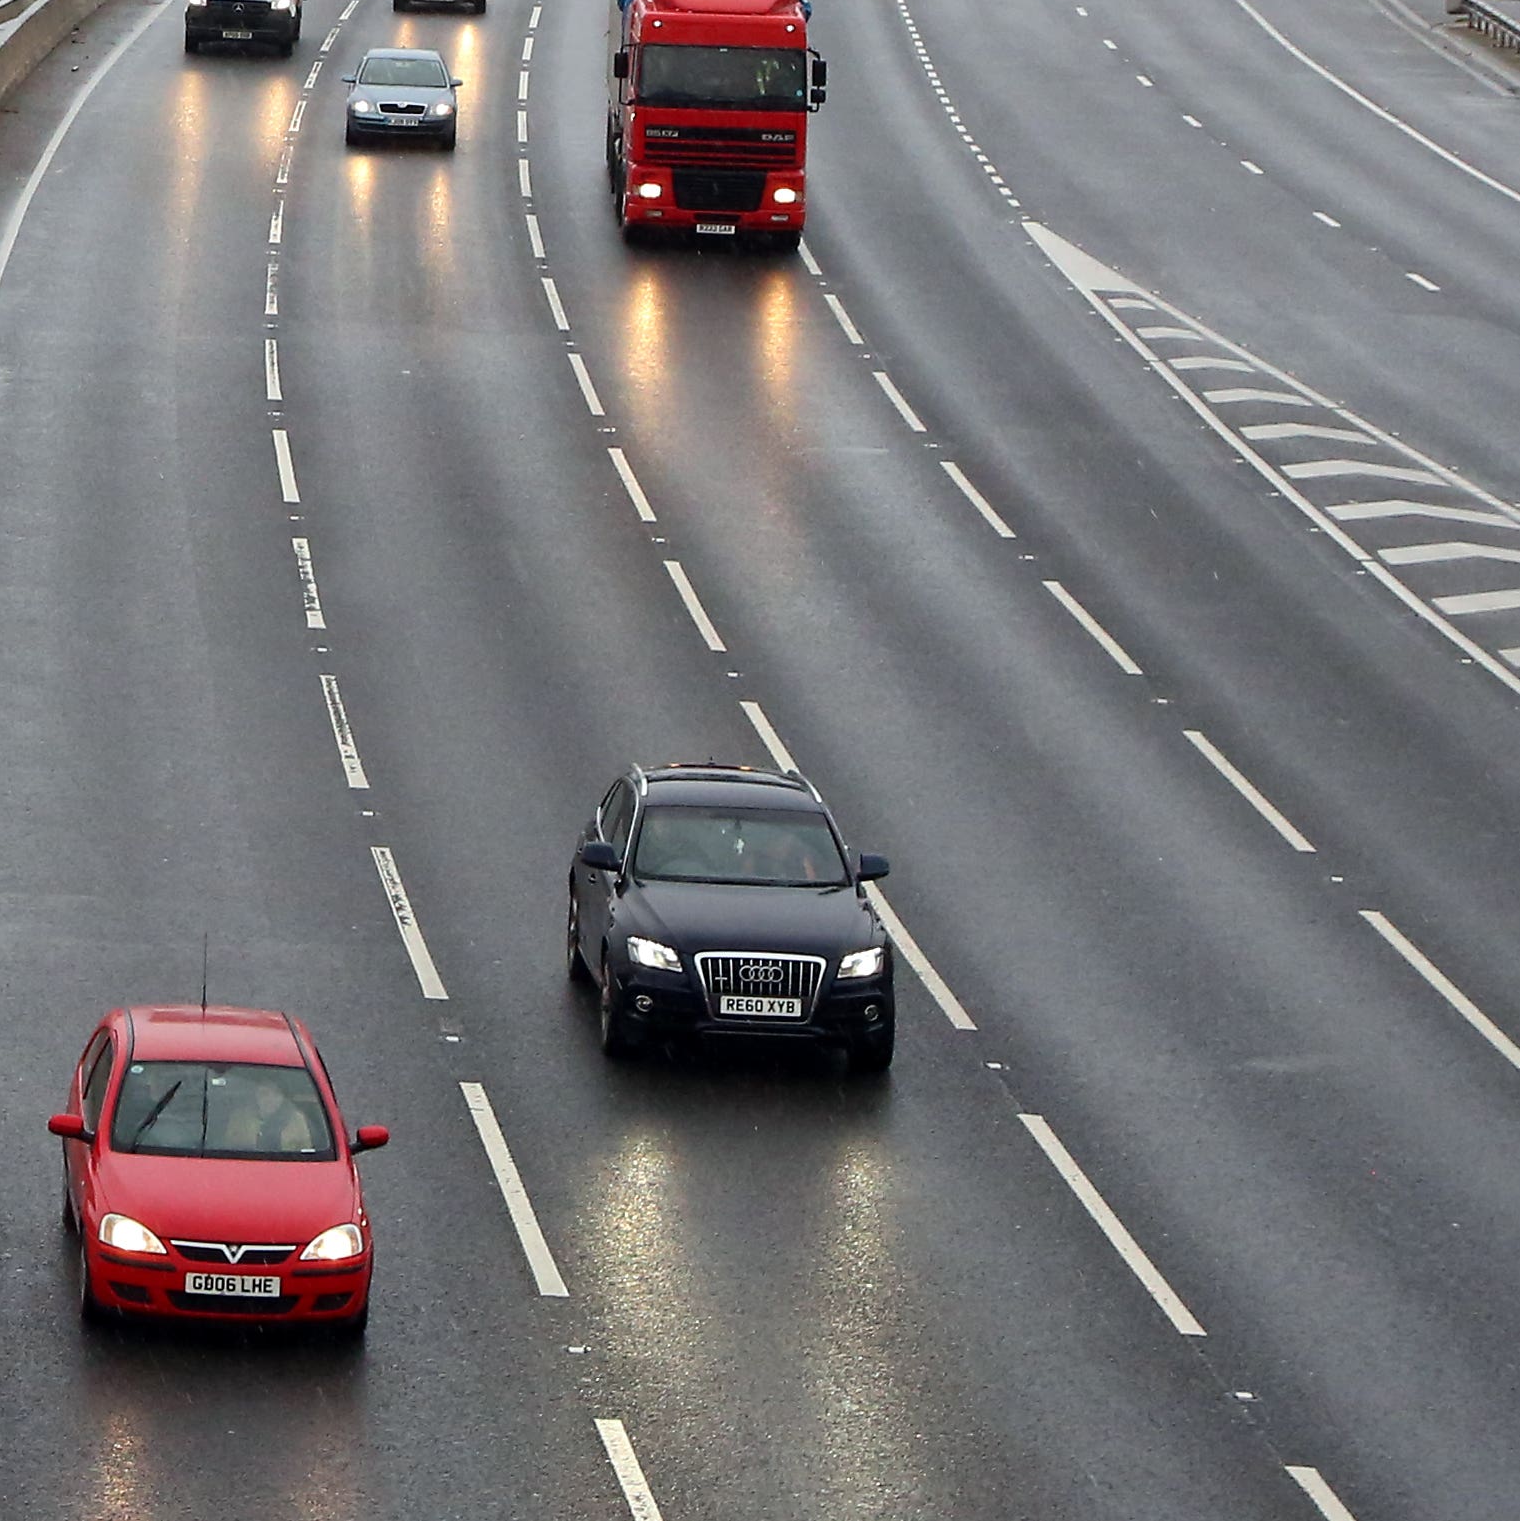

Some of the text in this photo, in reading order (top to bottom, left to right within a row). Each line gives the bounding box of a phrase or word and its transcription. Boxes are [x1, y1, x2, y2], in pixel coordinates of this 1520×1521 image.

[726, 998, 795, 1014] RE60 XYB
[240, 1278, 274, 1293] LHE
